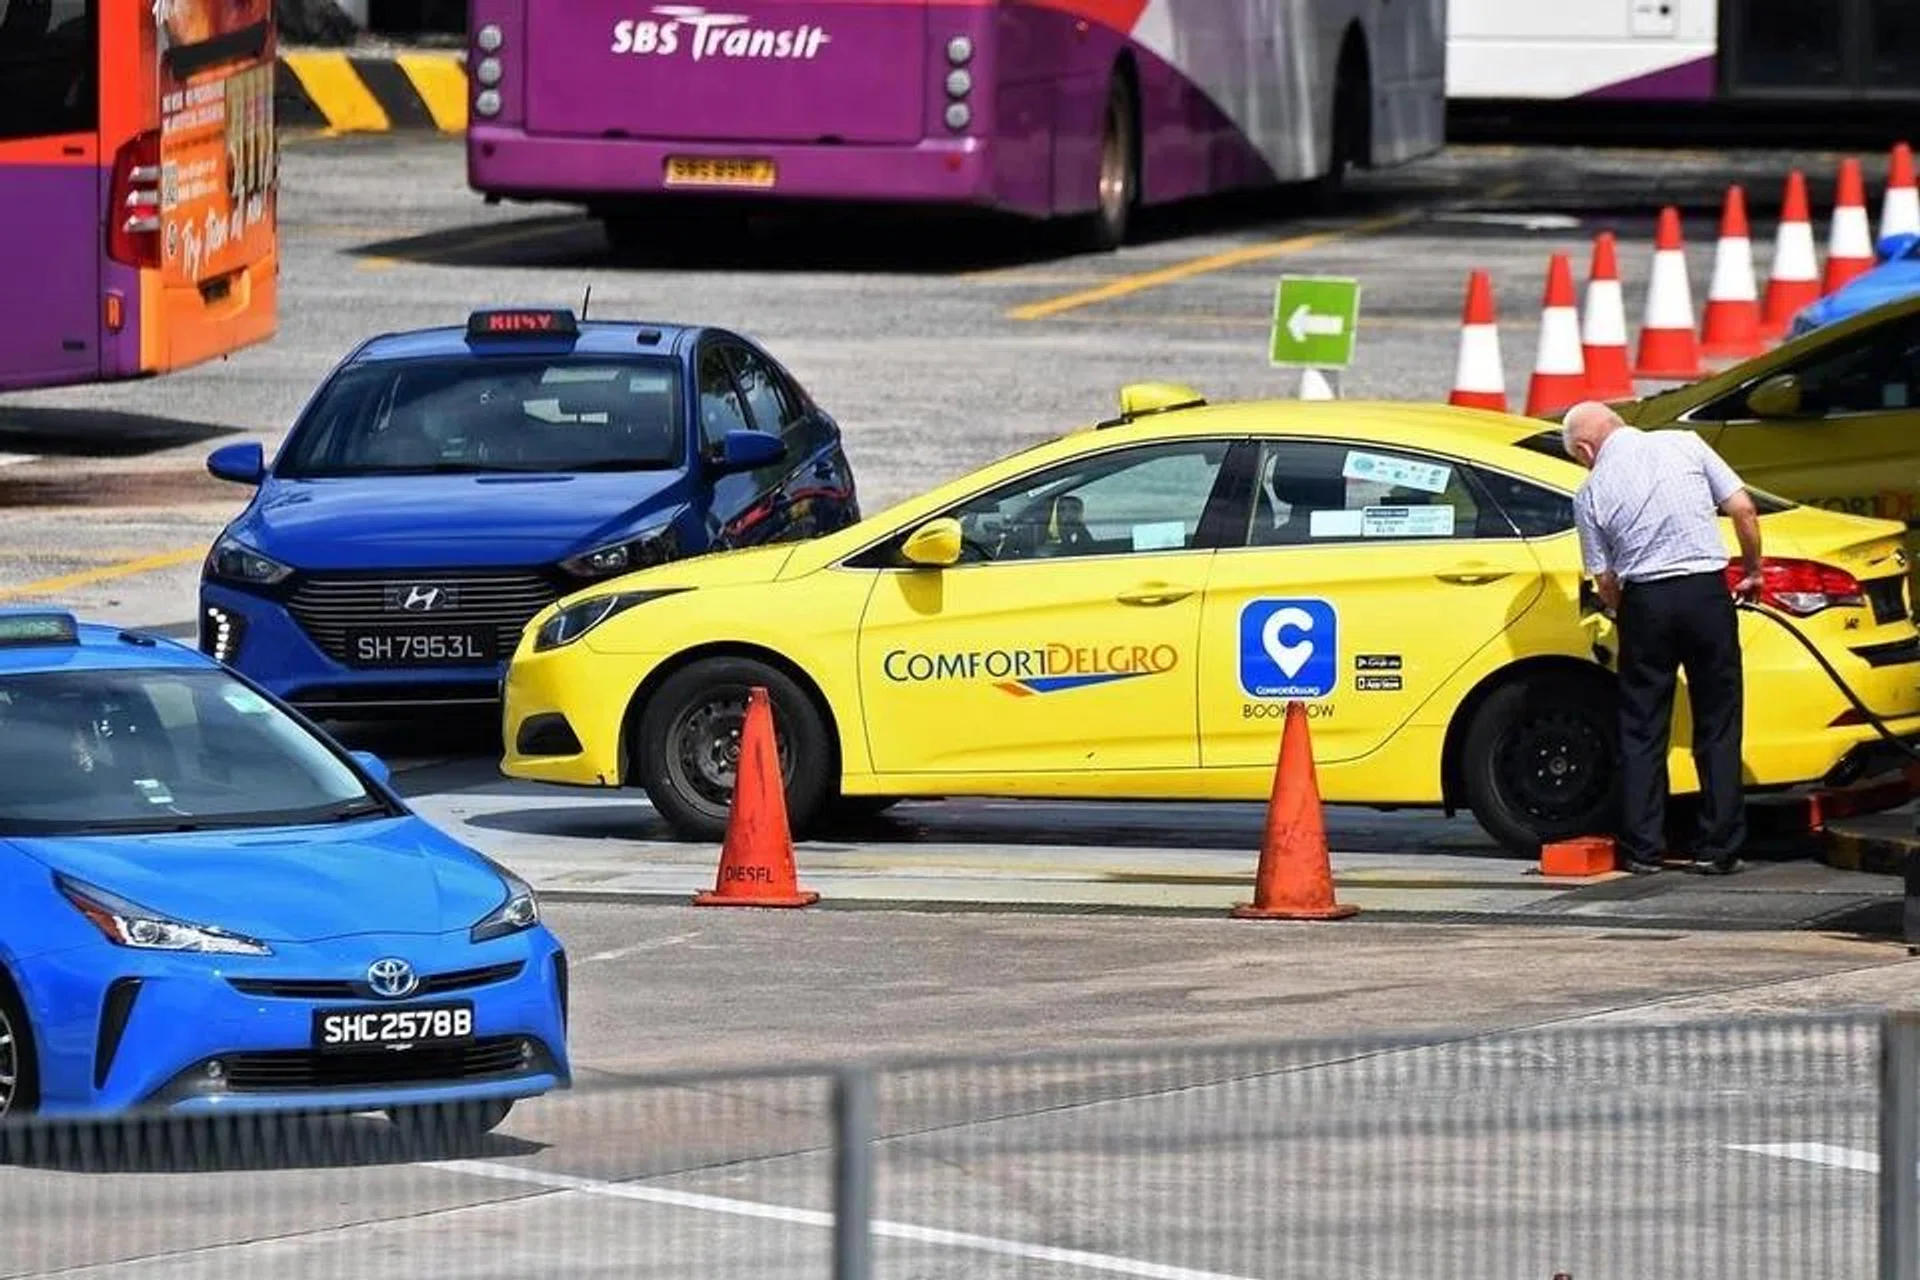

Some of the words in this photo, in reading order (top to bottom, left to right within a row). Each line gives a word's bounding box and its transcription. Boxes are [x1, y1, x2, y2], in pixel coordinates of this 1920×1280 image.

[611, 19, 679, 55] SBS
[652, 5, 832, 62] Transit
[357, 634, 484, 660] SH7953L
[1307, 703, 1336, 719] OW
[324, 1008, 472, 1044] SHC2578B
